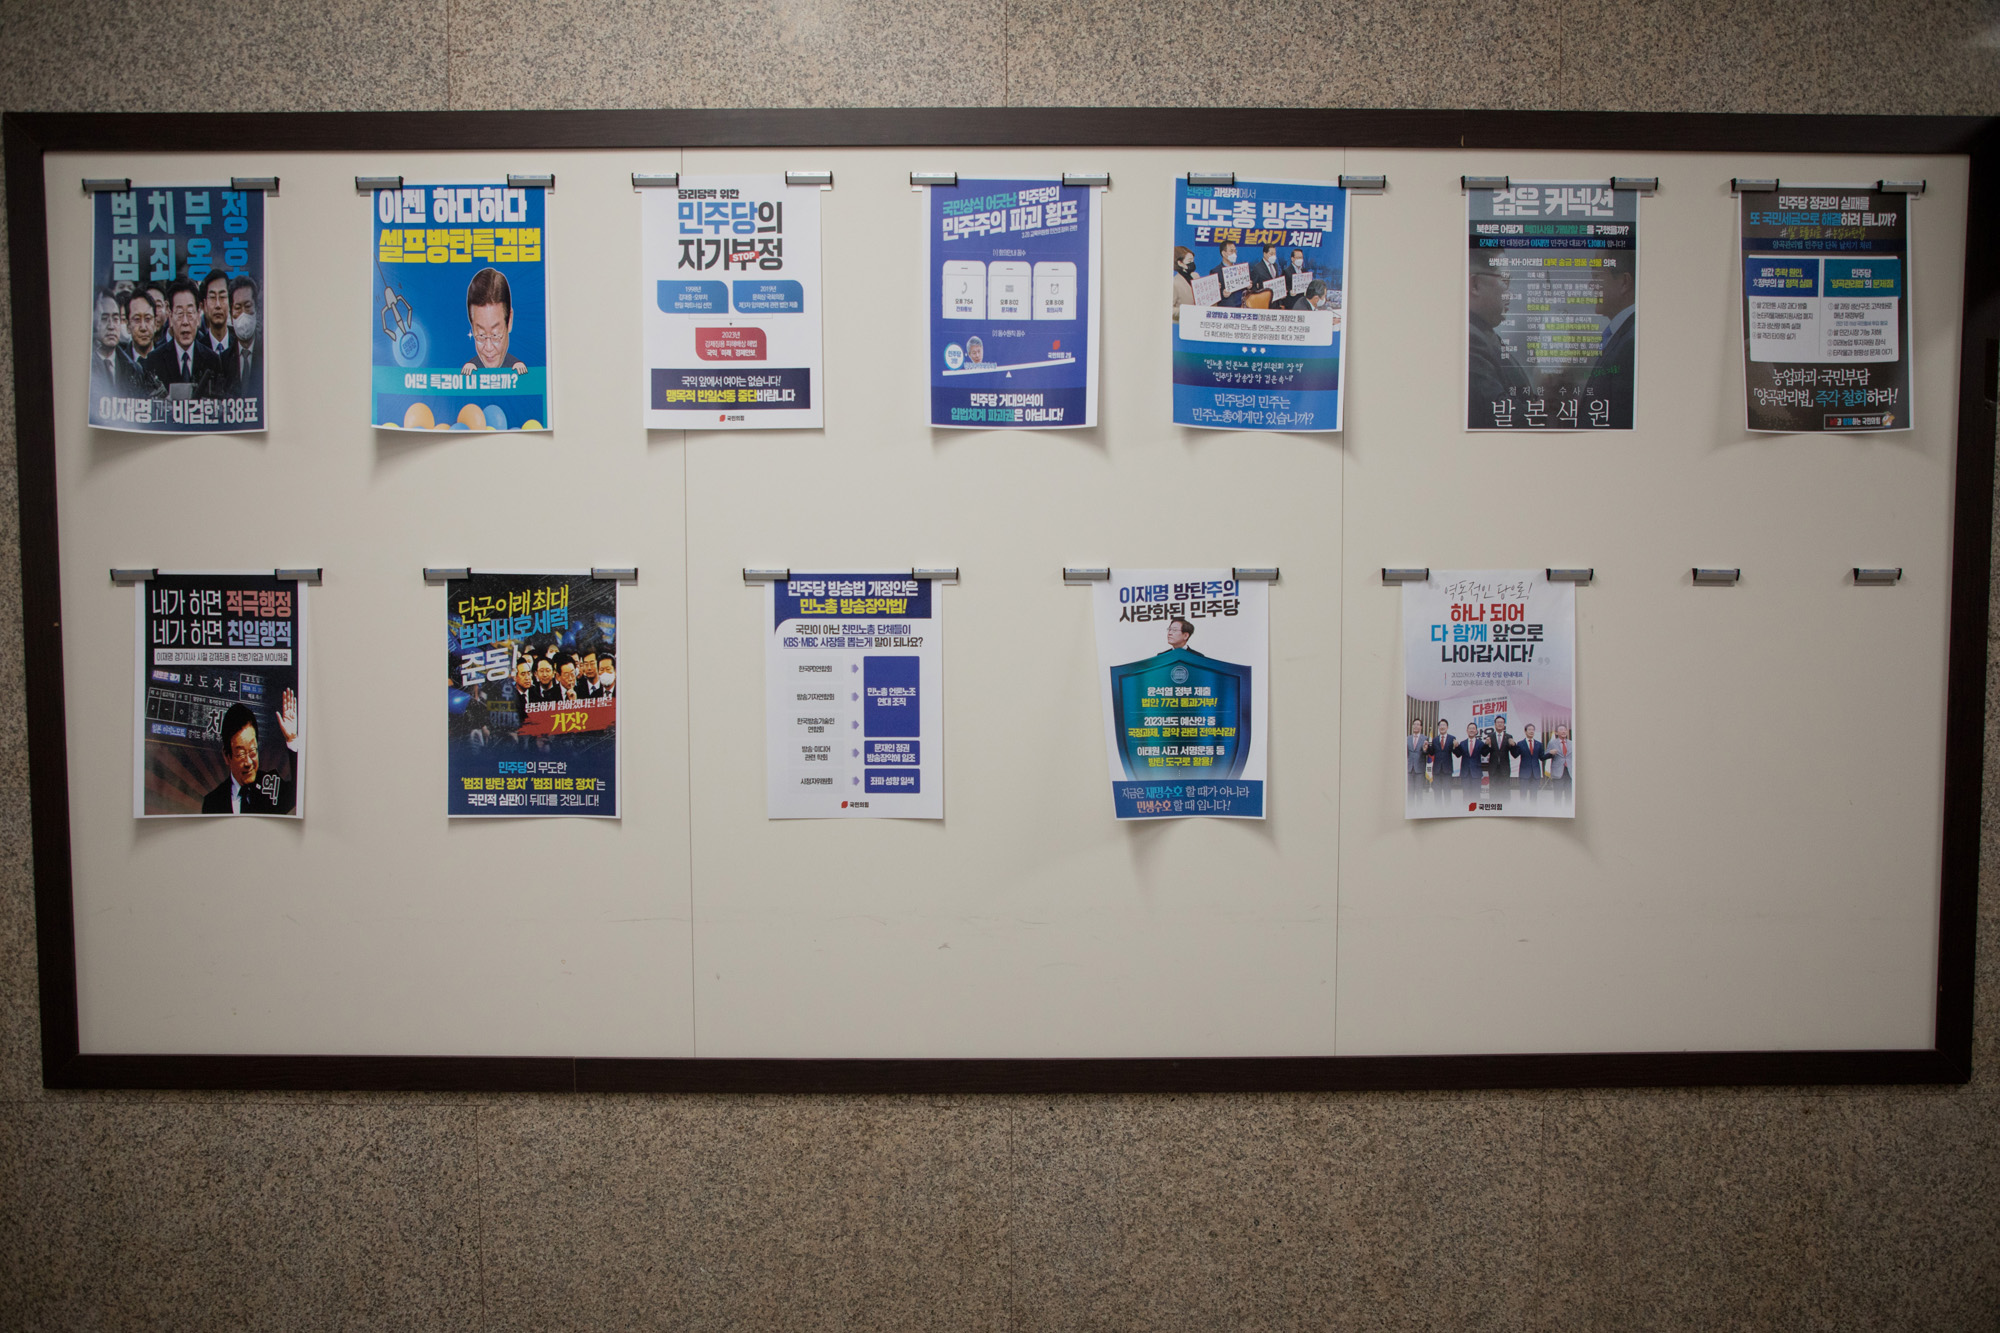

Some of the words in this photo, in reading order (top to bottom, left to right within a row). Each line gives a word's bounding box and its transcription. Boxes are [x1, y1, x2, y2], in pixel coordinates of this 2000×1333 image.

[720, 189, 739, 199] 위한
[1187, 187, 1213, 196] 민주당
[1214, 188, 1256, 199] 과방위에서
[379, 189, 426, 223] 이젠
[433, 187, 527, 223] 하다하다
[943, 196, 983, 216] 국민상식
[986, 192, 1017, 210] 어긋난
[1019, 186, 1059, 206] 민주당의
[1493, 188, 1539, 216] 검은
[1545, 188, 1613, 216] 커넥션
[1779, 196, 1808, 209] 민주당
[1810, 196, 1838, 209] 정권의
[1841, 197, 1869, 209] 실패를
[678, 202, 782, 234] 민주당의
[943, 210, 1006, 241] 민주주의
[1010, 205, 1042, 231] 파괴
[1046, 200, 1077, 227] 횡포
[1186, 198, 1256, 228] 민노총
[1263, 202, 1333, 232] 방송법
[1750, 213, 1760, 225] 또
[1762, 212, 1819, 225] 국민세금으로
[1822, 213, 1860, 226] 해결하려
[1863, 213, 1897, 226] 듭니까?
[1195, 227, 1210, 242] 또
[1214, 228, 1242, 244] 단독
[1245, 229, 1287, 245] 날치기
[1289, 232, 1322, 247] 처리!
[732, 253, 755, 261] STOP
[405, 374, 427, 389] 어떤
[431, 374, 463, 389] 특검이
[466, 374, 476, 389] 내
[480, 374, 518, 389] 편일까?
[682, 377, 697, 387] 국익
[699, 377, 722, 387] 앞에서
[724, 377, 746, 387] 여야는
[748, 376, 781, 387] 없습니다!
[666, 390, 695, 402] 맹목적
[698, 390, 735, 402] 반일선동
[738, 390, 795, 402] 중단바랍니다
[971, 394, 997, 407] 민주당
[999, 394, 1043, 406] 거대의석이
[1215, 394, 1255, 408] 민주당의
[1259, 396, 1290, 409] 민주는
[1816, 390, 1840, 407] 즉각
[1842, 388, 1898, 407] 철회하라!
[99, 398, 168, 424] 이재명과
[173, 398, 219, 424] 비겁한
[222, 398, 258, 423] 138표
[951, 408, 986, 421] 입법체계
[988, 409, 1023, 421] 파괴권은
[1025, 408, 1064, 421] 아닙니다!
[1193, 409, 1263, 424] 민주노총에게만
[1266, 412, 1314, 425] 있습니까?
[788, 581, 826, 596] 민주당
[828, 581, 866, 596] 방송법
[868, 581, 918, 596] 개정안은
[1120, 584, 1168, 603] 이재명
[1174, 580, 1239, 600] 방탄주의
[152, 590, 185, 615] 내가
[189, 590, 222, 616] 하면
[226, 591, 291, 617] 적극행정
[800, 599, 837, 614] 민노총
[840, 599, 907, 614] 방송장악법!
[1120, 602, 1185, 622] 사당화된
[1190, 599, 1240, 618] 민주당
[1451, 604, 1486, 622] 하나
[1490, 604, 1524, 622] 되어
[153, 620, 186, 645] 네가
[191, 620, 222, 645] 하면
[227, 620, 291, 647] 친일행적
[796, 625, 820, 634] 국민이
[823, 625, 840, 634] 아닌
[842, 625, 875, 635] 친민노총
[878, 625, 911, 635] 단체들이
[1431, 625, 1448, 642] 다
[1454, 624, 1487, 642] 함께
[1493, 624, 1543, 642] 앞으로
[821, 637, 845, 647] 사장을
[875, 637, 891, 647] 말이
[893, 637, 923, 647] 되나요?
[1442, 644, 1534, 662] 나아갑시다!
[461, 641, 518, 687] 준동!
[1148, 687, 1173, 696] 윤석열
[1175, 687, 1192, 696] 정부
[1194, 687, 1211, 696] 제출
[1142, 698, 1159, 707] 법안
[1161, 698, 1178, 707] 77건
[1473, 701, 1507, 715] 다함께
[551, 712, 588, 732] 거짓?
[1144, 717, 1178, 726] 2023년도
[1180, 717, 1206, 726] 예산안
[1207, 717, 1215, 726] 중
[499, 762, 536, 774] 민주당의
[538, 762, 567, 774] 무도한
[1148, 758, 1164, 766] 방탄
[1165, 758, 1190, 766] 도구로
[485, 778, 505, 790] 방탄
[555, 778, 574, 790] 비호
[1122, 788, 1144, 798] 지금은
[1185, 787, 1195, 797] 할
[1198, 787, 1218, 797] 때가
[1220, 786, 1250, 798] 아니라
[468, 794, 496, 806] 국민적
[499, 794, 527, 806] 심판이
[530, 795, 558, 806] 뒤따를
[560, 795, 599, 806] 것입니다!
[1173, 800, 1183, 811] 할
[1185, 800, 1195, 811] 때
[1197, 800, 1231, 811] 입니다!
